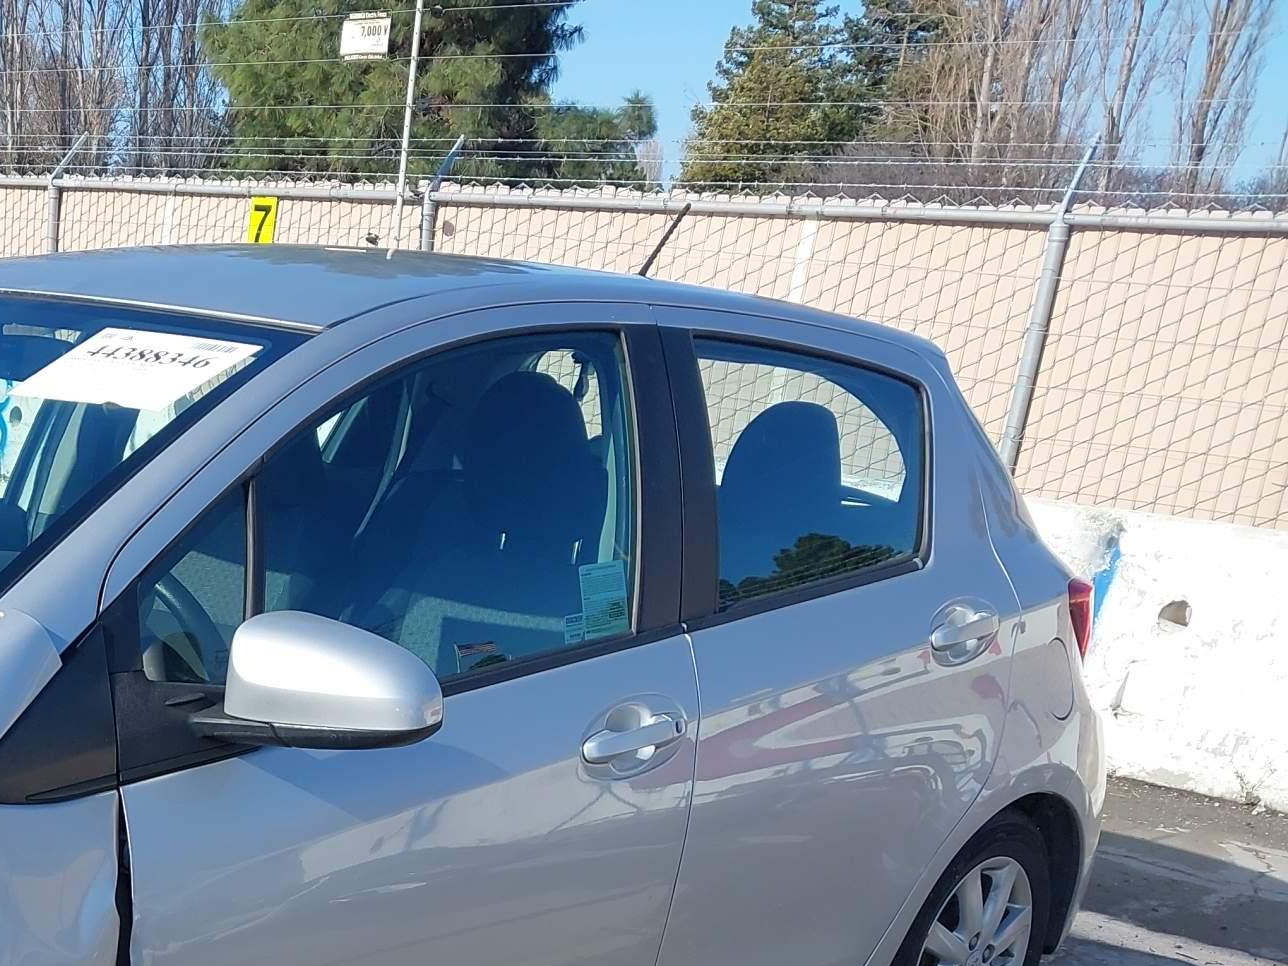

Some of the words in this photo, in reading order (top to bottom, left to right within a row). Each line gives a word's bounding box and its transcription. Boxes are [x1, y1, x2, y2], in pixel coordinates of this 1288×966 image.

[361, 25, 382, 37] 7,000
[254, 205, 273, 242] 7
[87, 345, 215, 368] 44388346
